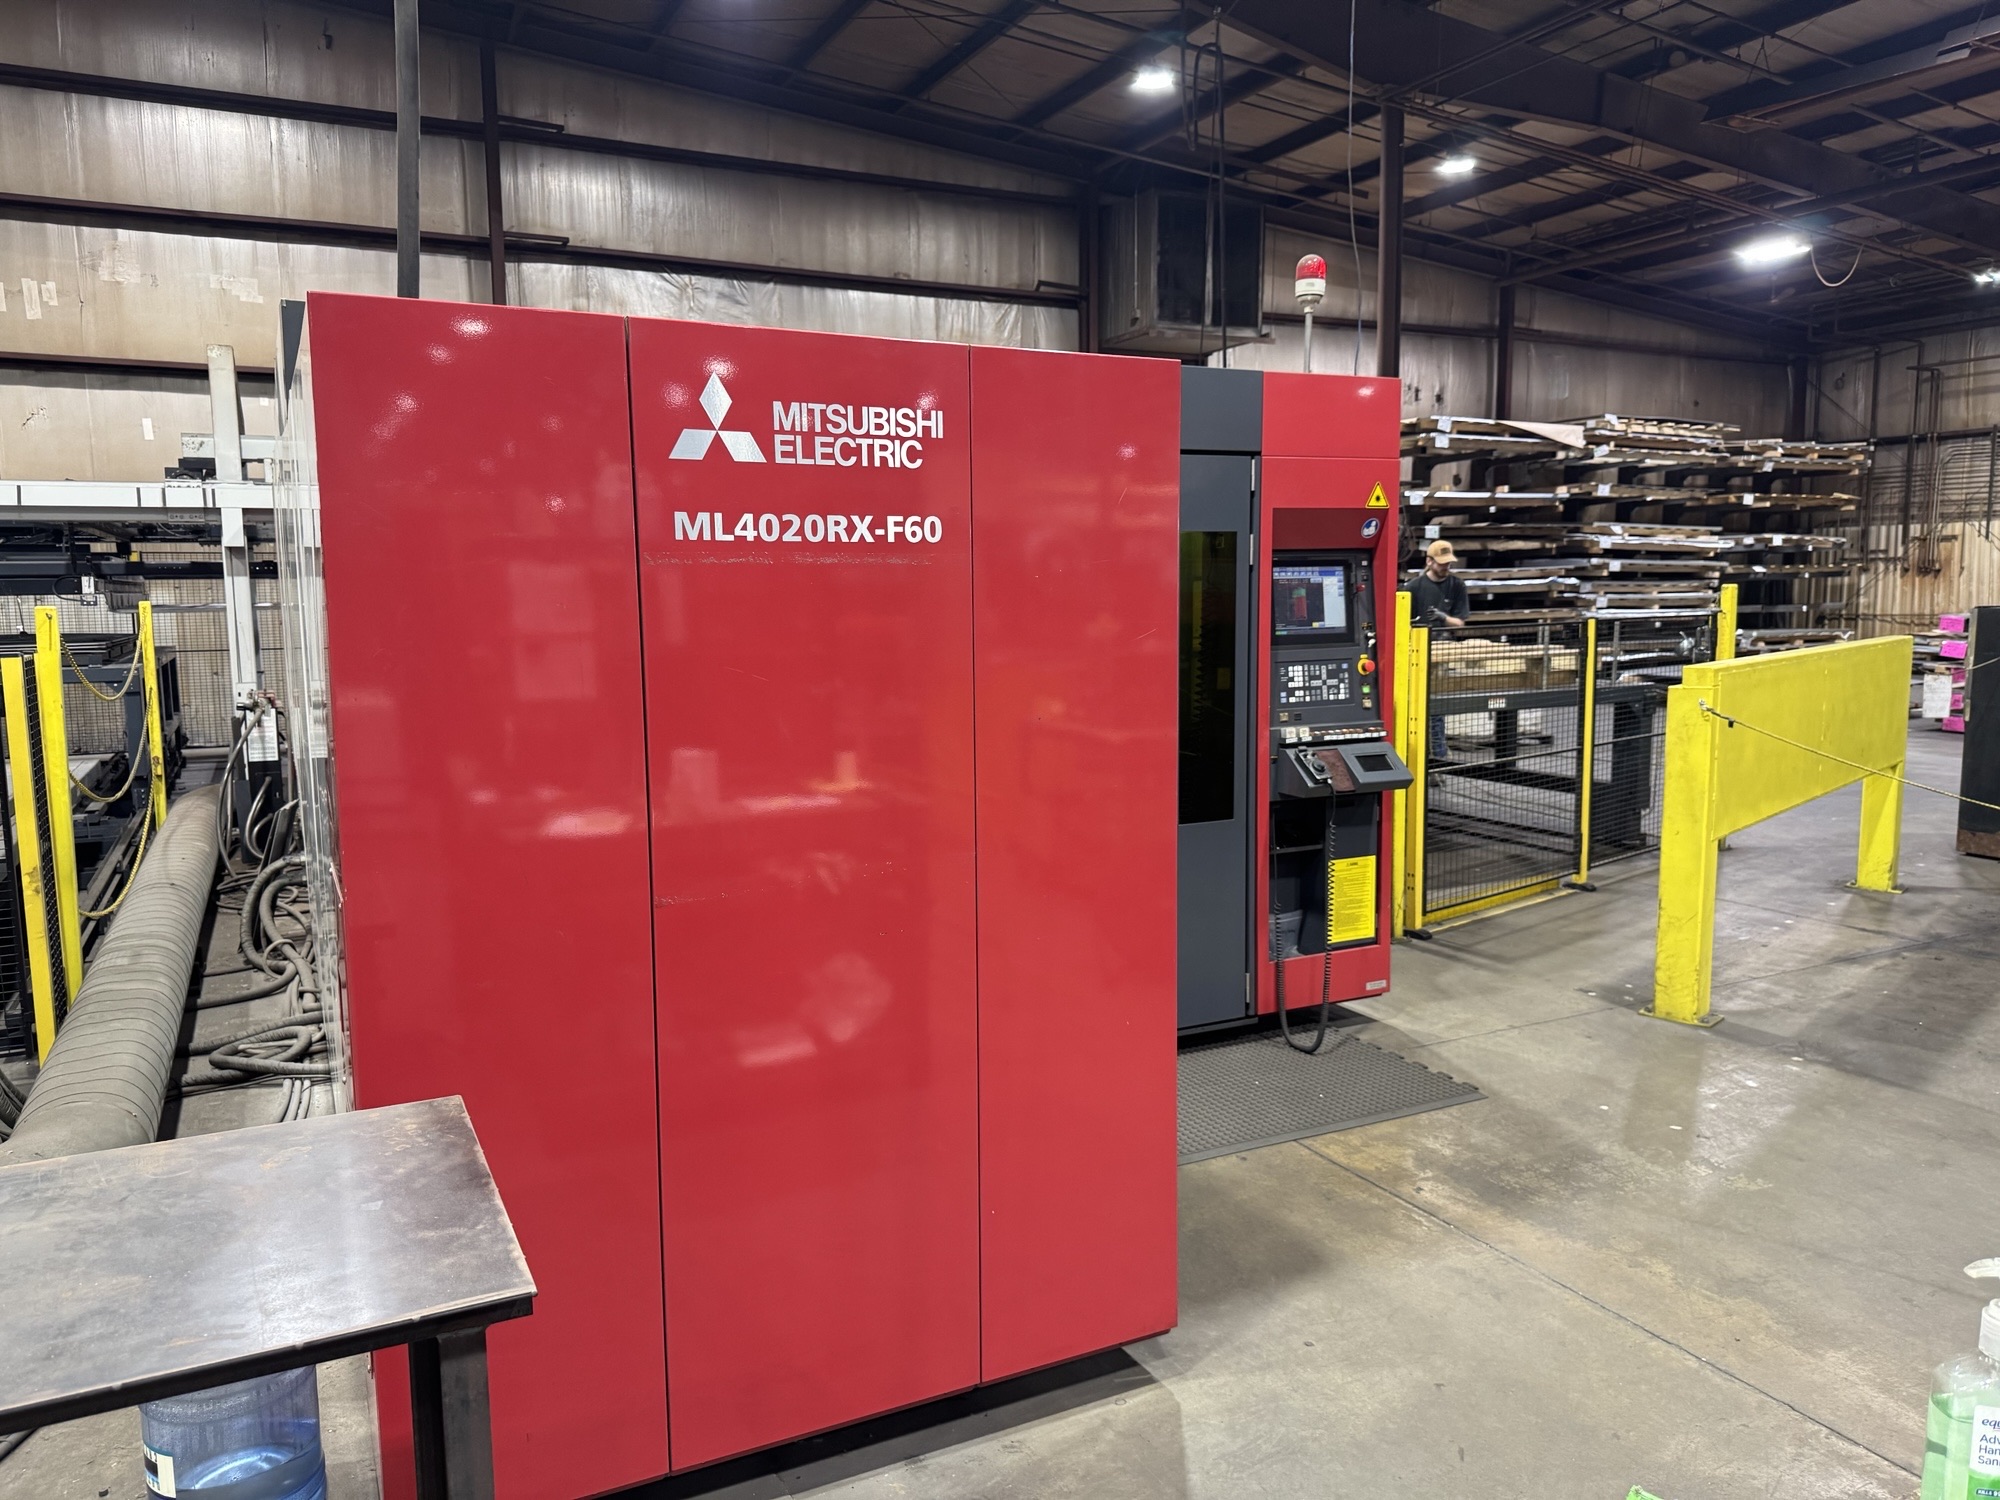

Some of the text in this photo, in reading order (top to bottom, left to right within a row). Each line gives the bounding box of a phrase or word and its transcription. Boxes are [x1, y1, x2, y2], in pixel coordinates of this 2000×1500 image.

[772, 400, 944, 439] MITSUBISHI
[774, 434, 924, 469] ELECTRIC
[673, 510, 943, 544] ML4020RX-F60
